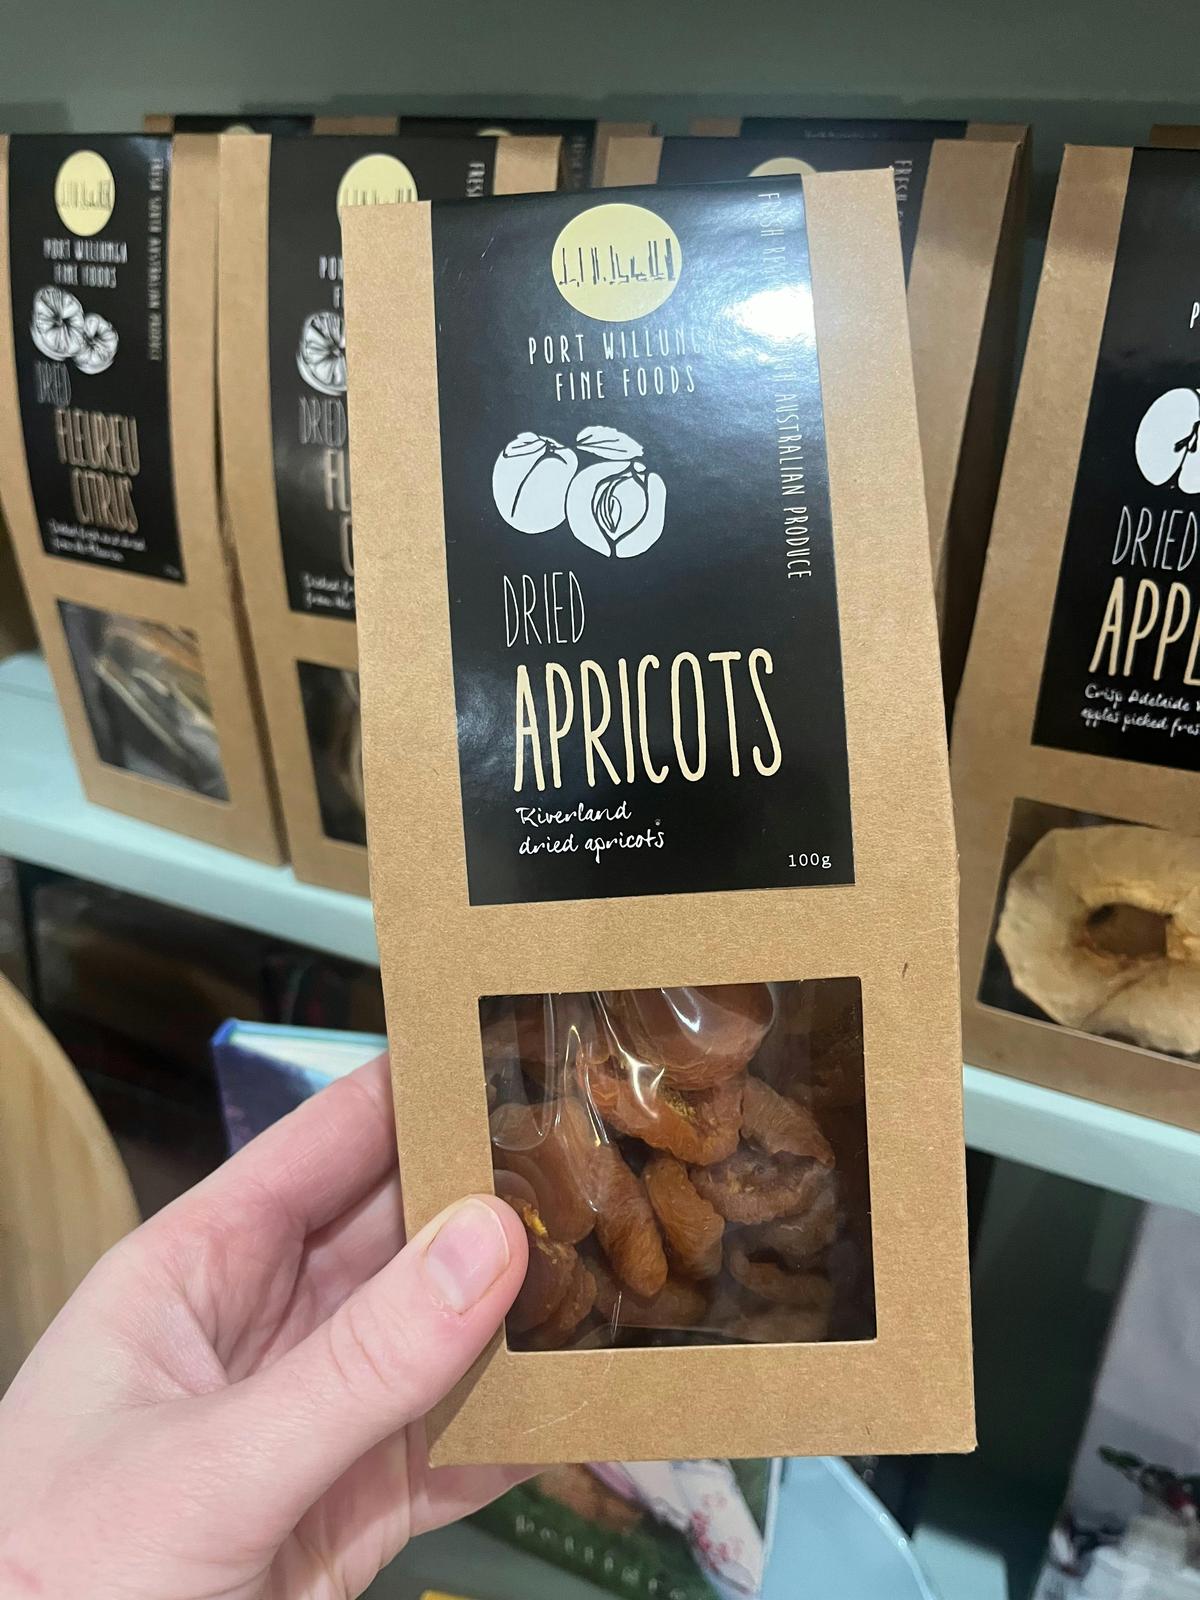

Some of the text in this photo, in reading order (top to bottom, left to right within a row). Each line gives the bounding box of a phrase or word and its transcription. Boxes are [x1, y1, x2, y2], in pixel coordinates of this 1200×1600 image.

[528, 333, 584, 365] PORT
[555, 364, 695, 401] FINE FOODS
[775, 393, 806, 496] AUSTRALIAN
[783, 506, 812, 580] PRODUCE
[1112, 505, 1198, 571] DRIED
[503, 571, 586, 648] DRIED
[1085, 683, 1123, 709] Crisp
[1128, 689, 1190, 712] Adelaide
[514, 648, 782, 791] APRICOTS
[1121, 713, 1169, 732] picked
[515, 801, 632, 827] Riverland
[518, 828, 666, 864] dried apricots
[788, 852, 833, 870] 100g
